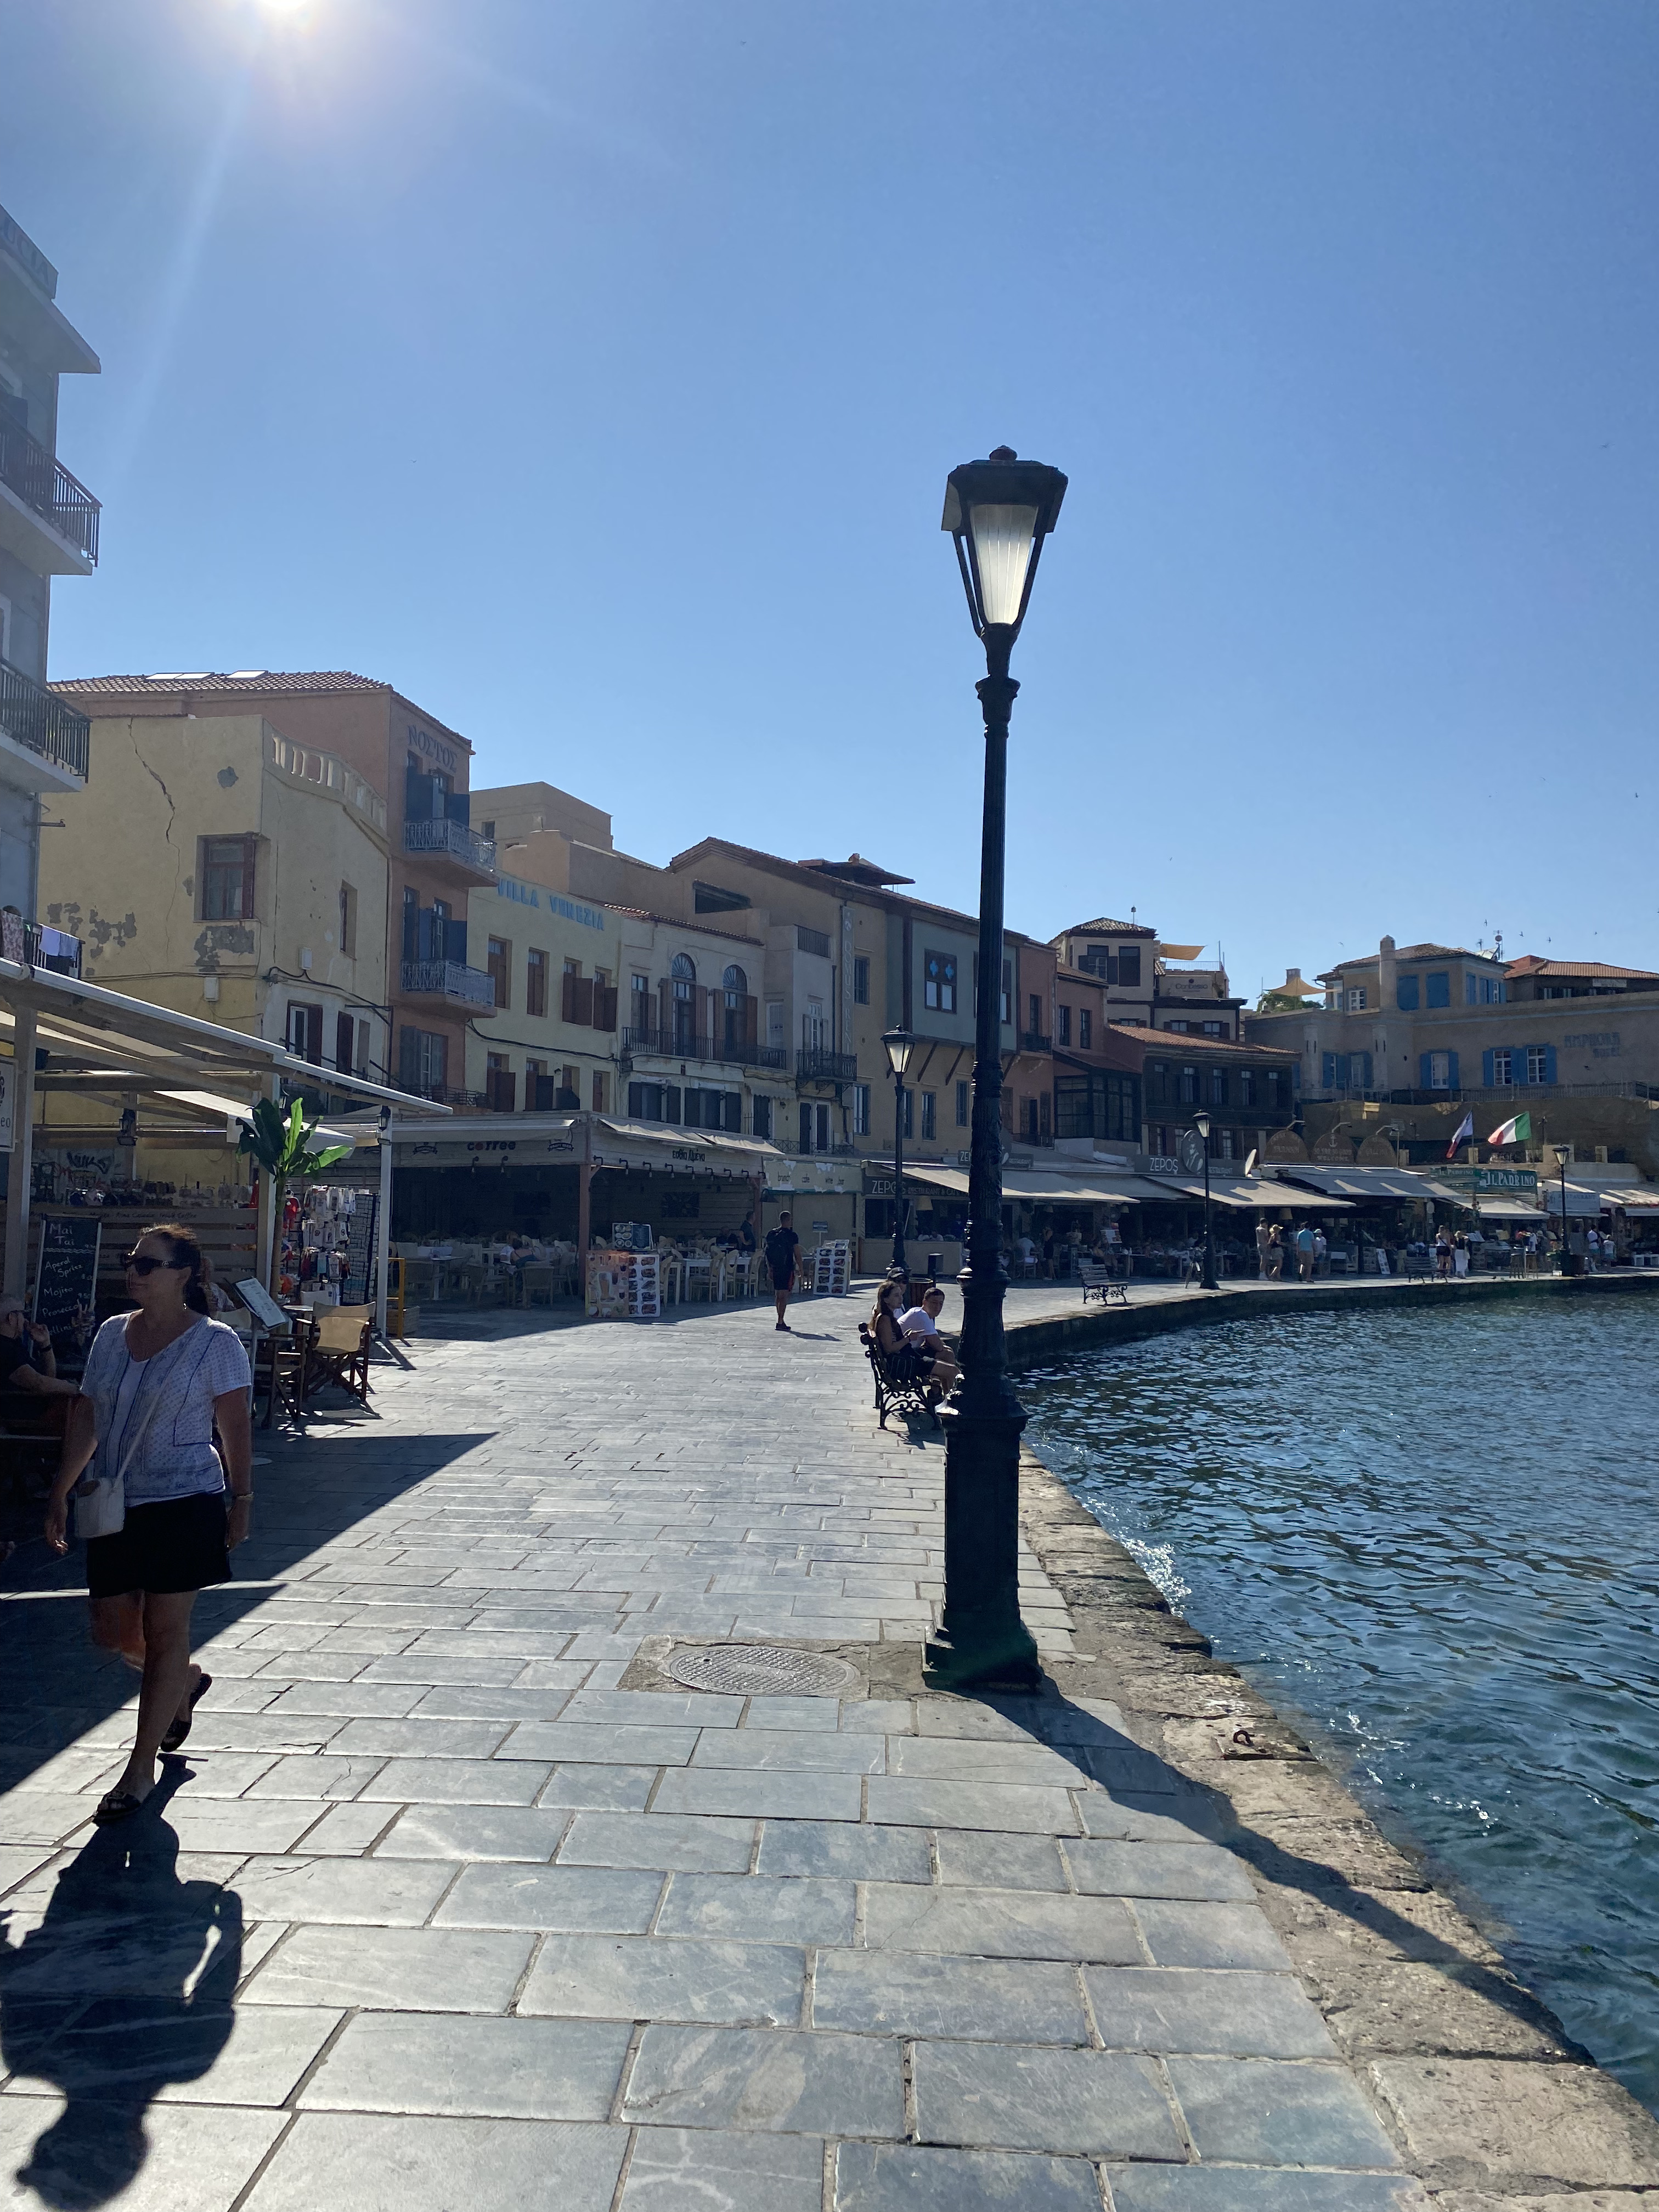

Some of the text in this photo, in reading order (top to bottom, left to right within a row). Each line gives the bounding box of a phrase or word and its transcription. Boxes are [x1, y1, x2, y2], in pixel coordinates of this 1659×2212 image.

[0, 216, 49, 289] UCIA
[498, 878, 605, 932] VILLA VENEZIA
[961, 1151, 972, 1161] ZEP
[1150, 1158, 1178, 1172] ZEPOS
[778, 1171, 791, 1182] brunch
[1498, 1172, 1535, 1187] PADRINO
[50, 1223, 73, 1234] Mai
[54, 1235, 75, 1245] Tai
[45, 1256, 70, 1272] Aperol
[44, 1287, 73, 1298] Mojito
[42, 1304, 78, 1317] Prosecco
